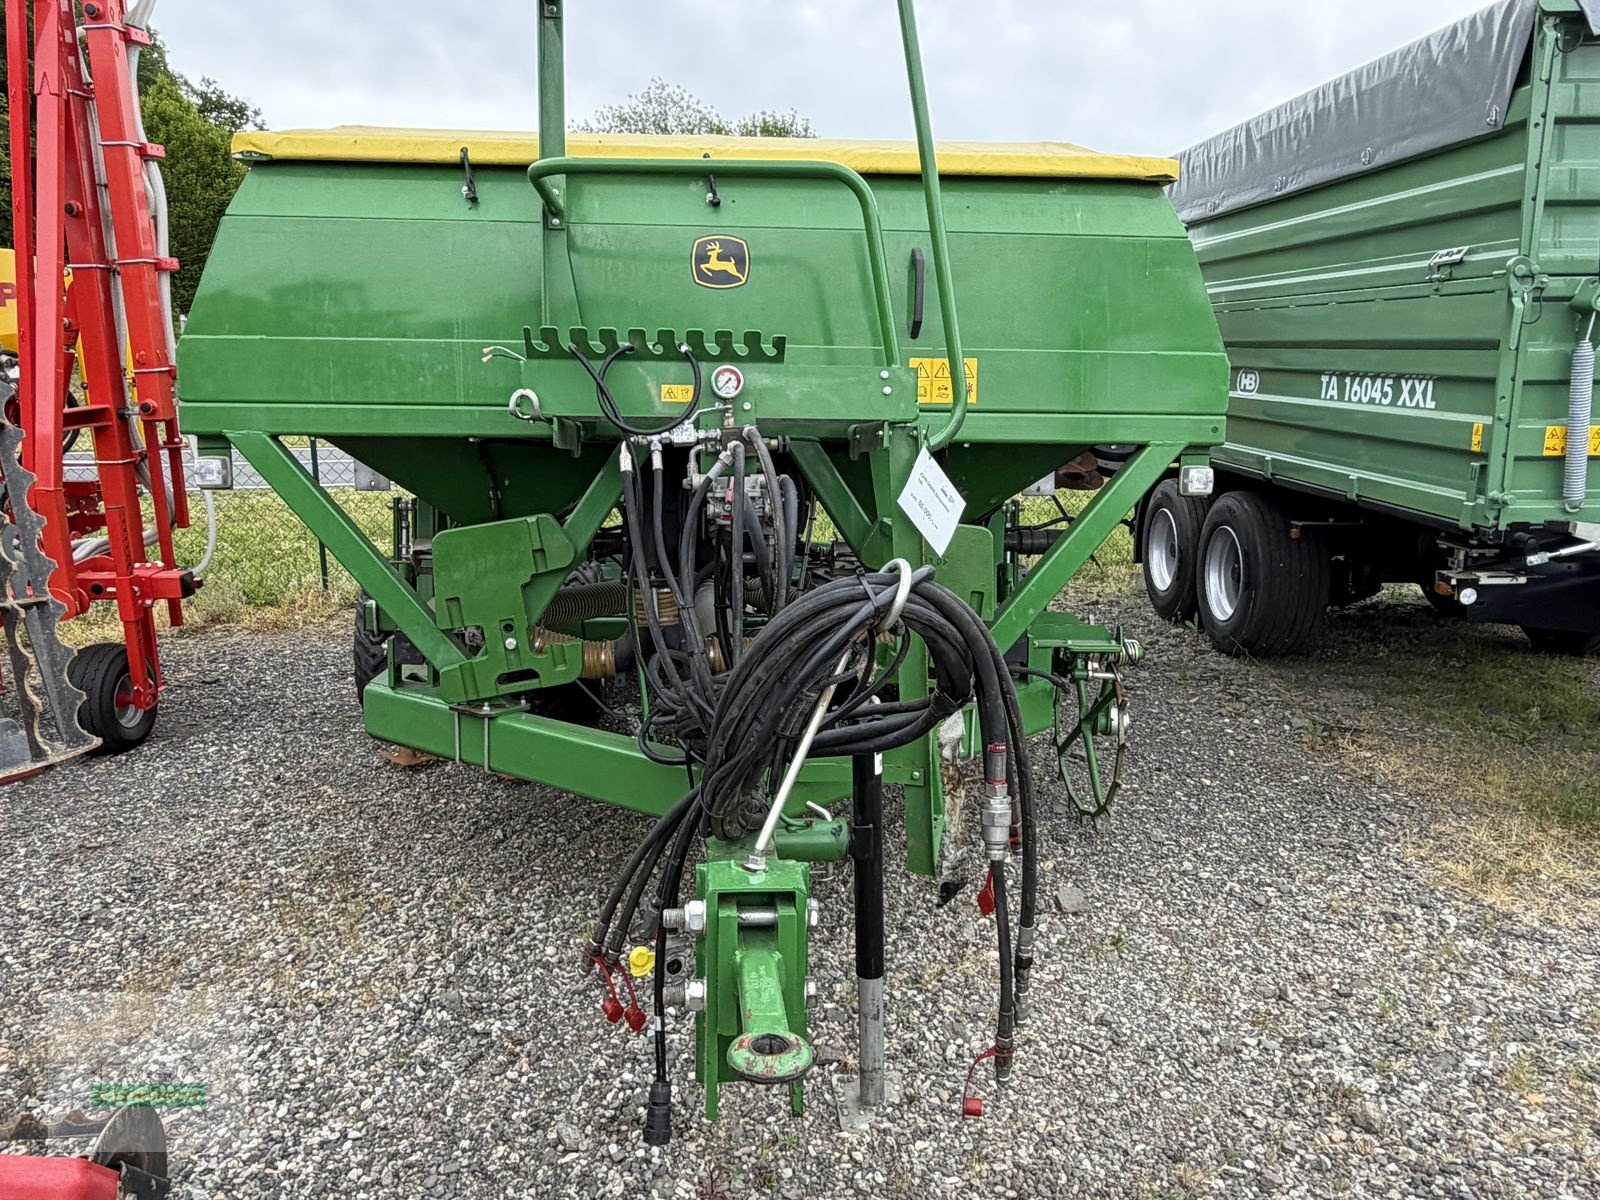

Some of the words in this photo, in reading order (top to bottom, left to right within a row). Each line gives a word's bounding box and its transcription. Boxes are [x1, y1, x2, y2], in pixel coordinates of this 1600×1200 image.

[1239, 372, 1257, 391] HB
[1320, 375, 1338, 400] TA
[1343, 376, 1394, 405] 16045
[1397, 378, 1436, 409] XXL
